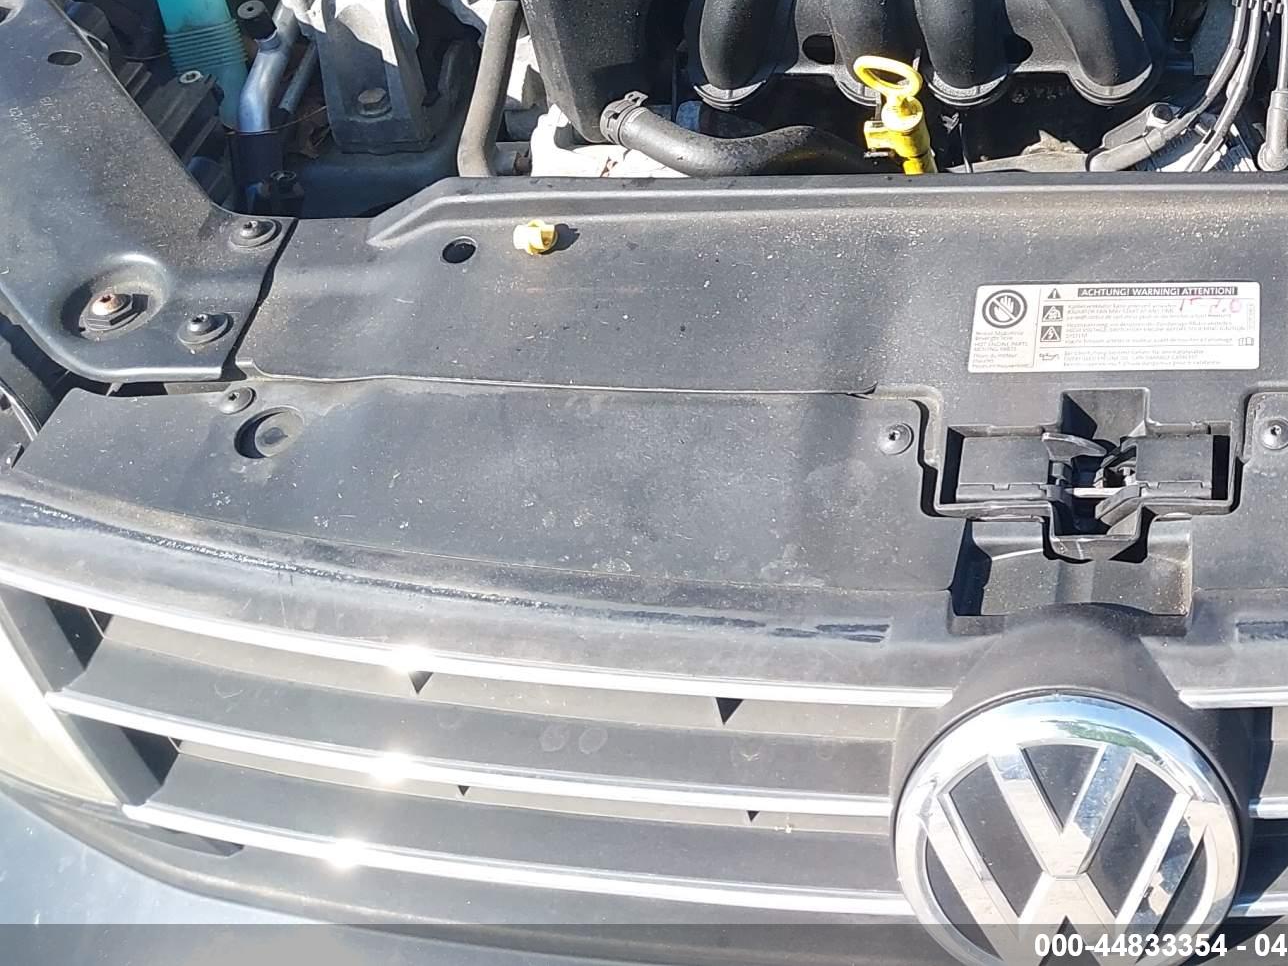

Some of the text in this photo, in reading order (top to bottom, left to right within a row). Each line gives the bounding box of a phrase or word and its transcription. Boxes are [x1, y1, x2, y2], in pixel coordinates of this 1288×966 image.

[1080, 287, 1236, 296] ACHTUNG! WARNING! ATTENTION!
